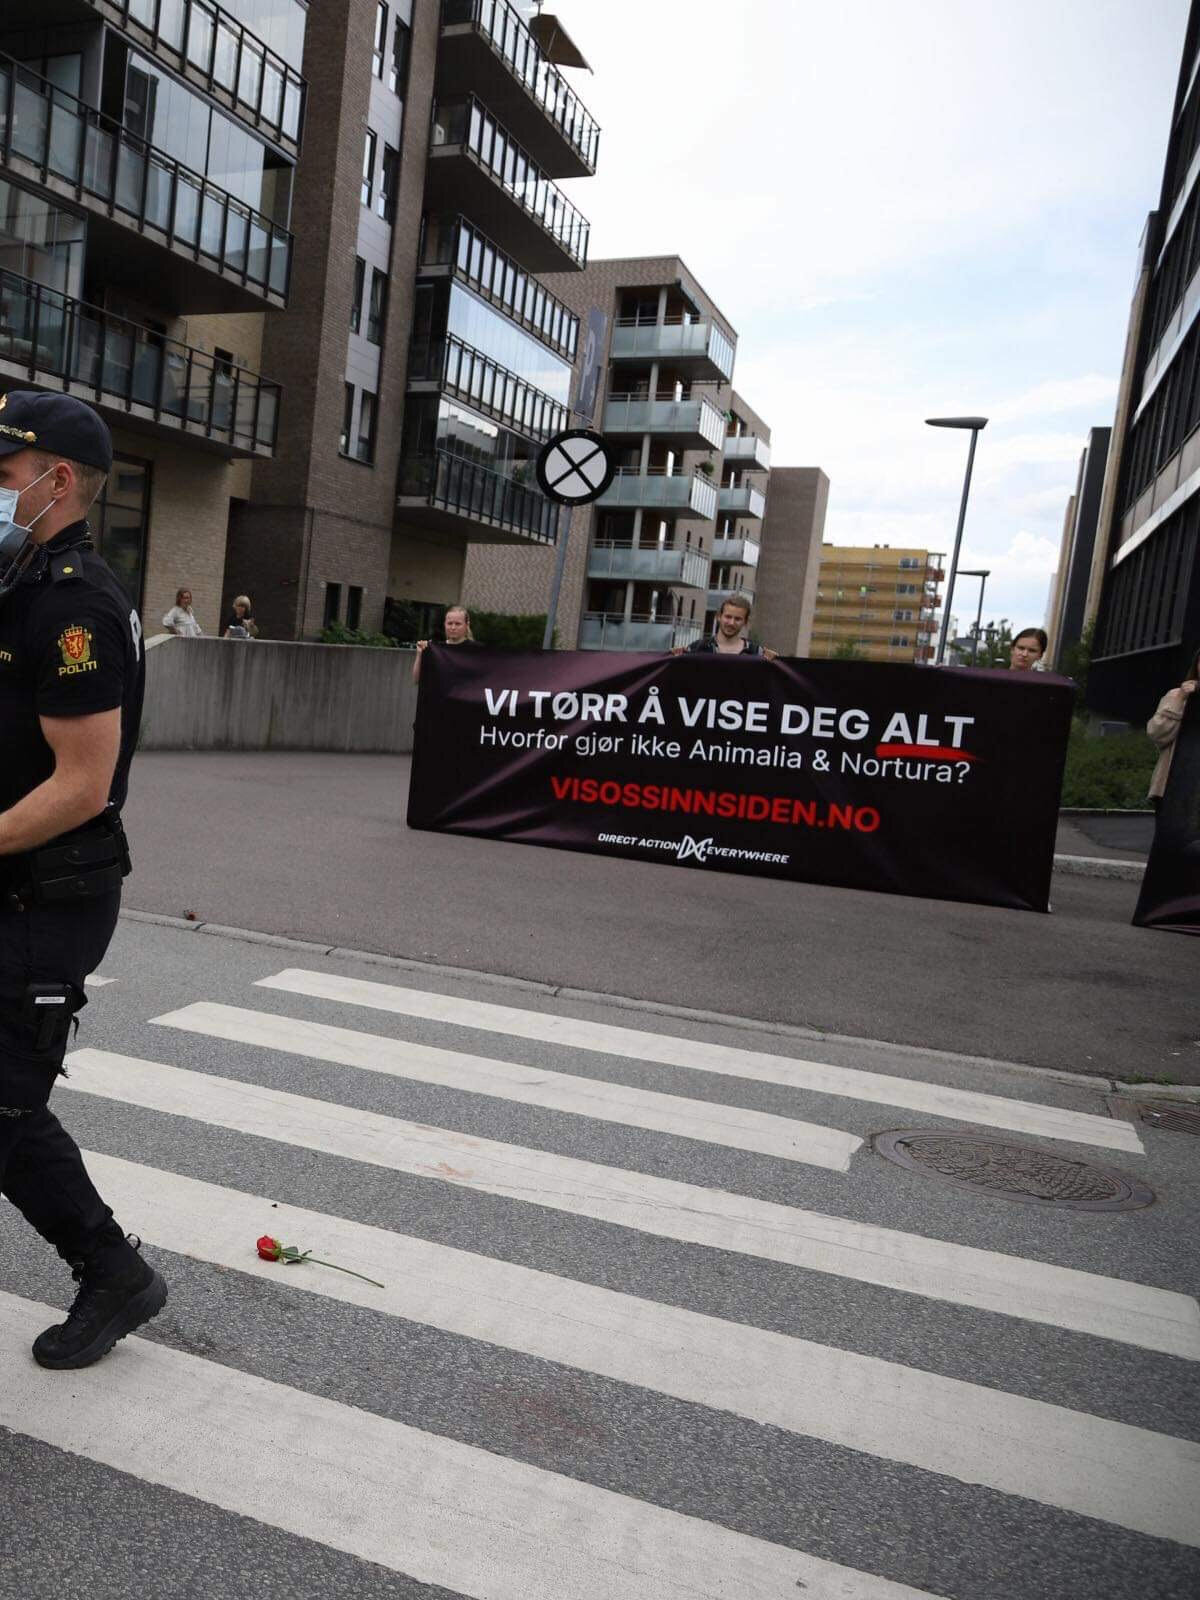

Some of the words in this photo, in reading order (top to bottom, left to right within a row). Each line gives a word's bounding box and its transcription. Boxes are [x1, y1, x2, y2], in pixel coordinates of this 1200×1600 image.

[58, 660, 97, 676] POLITI
[484, 688, 519, 718] VI
[528, 691, 628, 723] TØRR
[638, 686, 666, 725] Å
[678, 697, 770, 733] VISE
[780, 703, 870, 741] DEG
[880, 712, 975, 749] ALT
[479, 725, 568, 750] Hvorfor
[575, 732, 624, 756] gjør
[631, 734, 681, 758] ikke
[689, 738, 802, 769] Animalia
[812, 749, 831, 772] &
[840, 751, 971, 784] Nortura?
[551, 776, 881, 833] VISOSSINNSIDEN.NO
[598, 832, 638, 846] DIRECT
[638, 838, 681, 851] ACTION
[707, 846, 790, 864] EVERYWHERE
